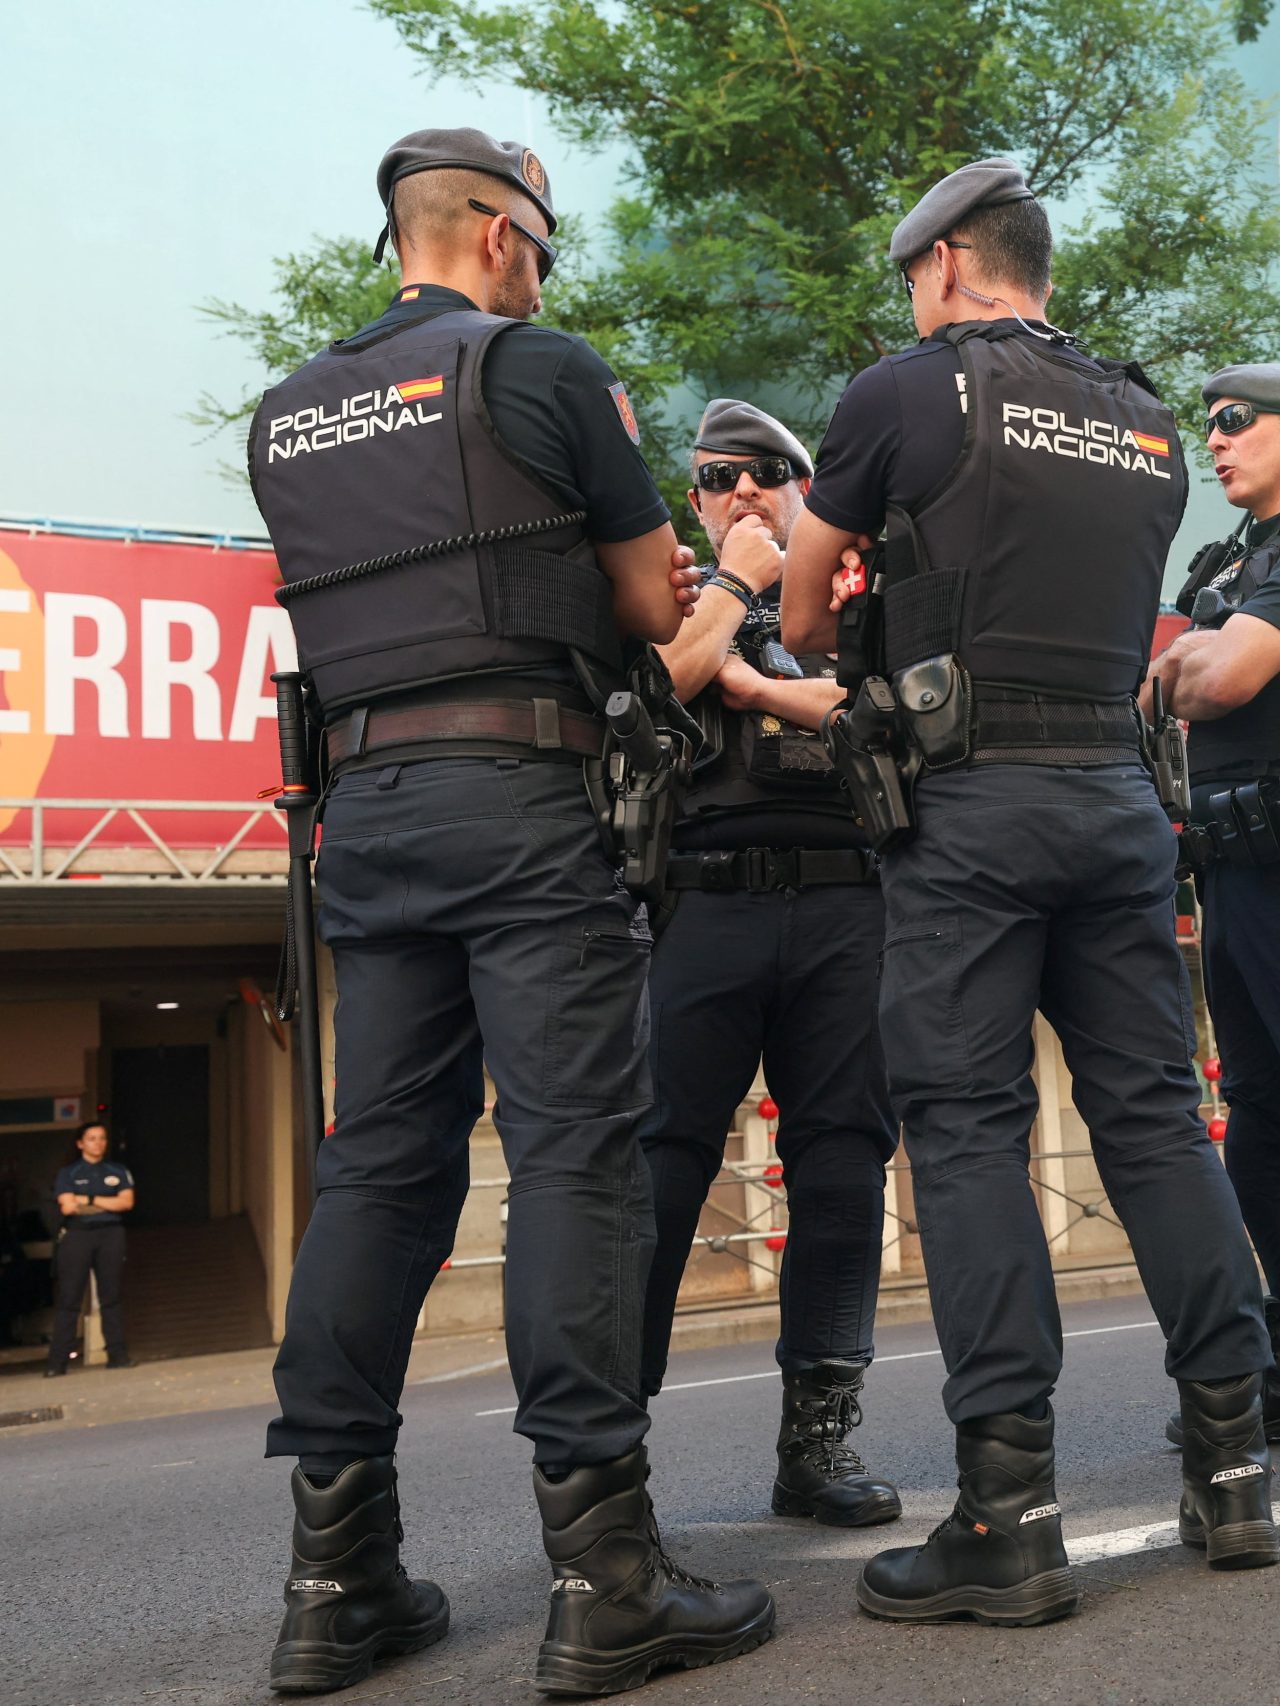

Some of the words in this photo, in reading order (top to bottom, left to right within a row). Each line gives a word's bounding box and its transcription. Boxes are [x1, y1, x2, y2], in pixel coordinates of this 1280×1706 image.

[268, 403, 443, 464] NACIONAL
[269, 385, 404, 440] POLICIA
[1003, 402, 1140, 450] POLICIA
[1003, 426, 1171, 480] NACIONAL
[1215, 1465, 1261, 1480] POLICIA
[290, 1581, 337, 1590] POLICIA
